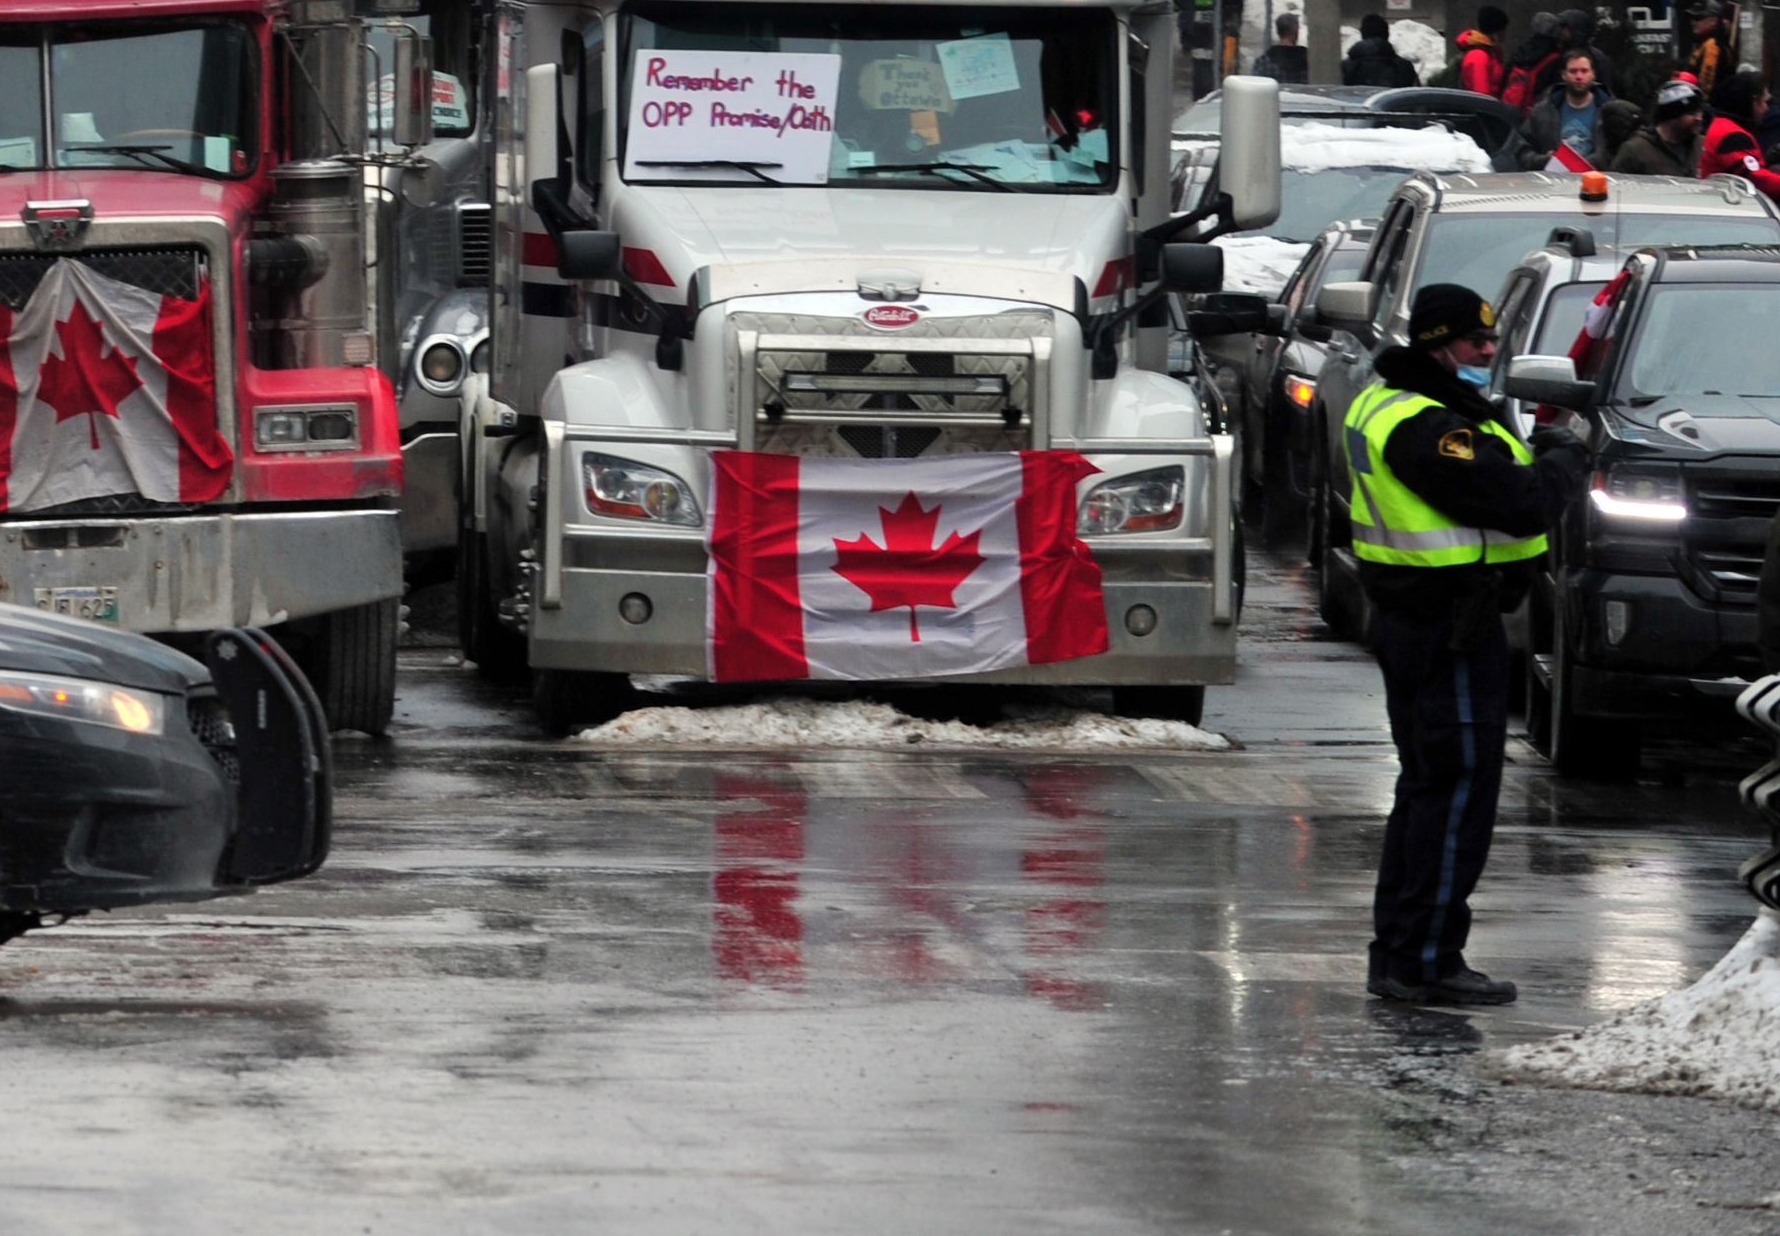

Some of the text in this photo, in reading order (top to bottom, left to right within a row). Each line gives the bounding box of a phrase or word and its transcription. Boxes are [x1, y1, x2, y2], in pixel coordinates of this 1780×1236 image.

[646, 58, 816, 99] Remember the
[642, 101, 692, 128] OPP
